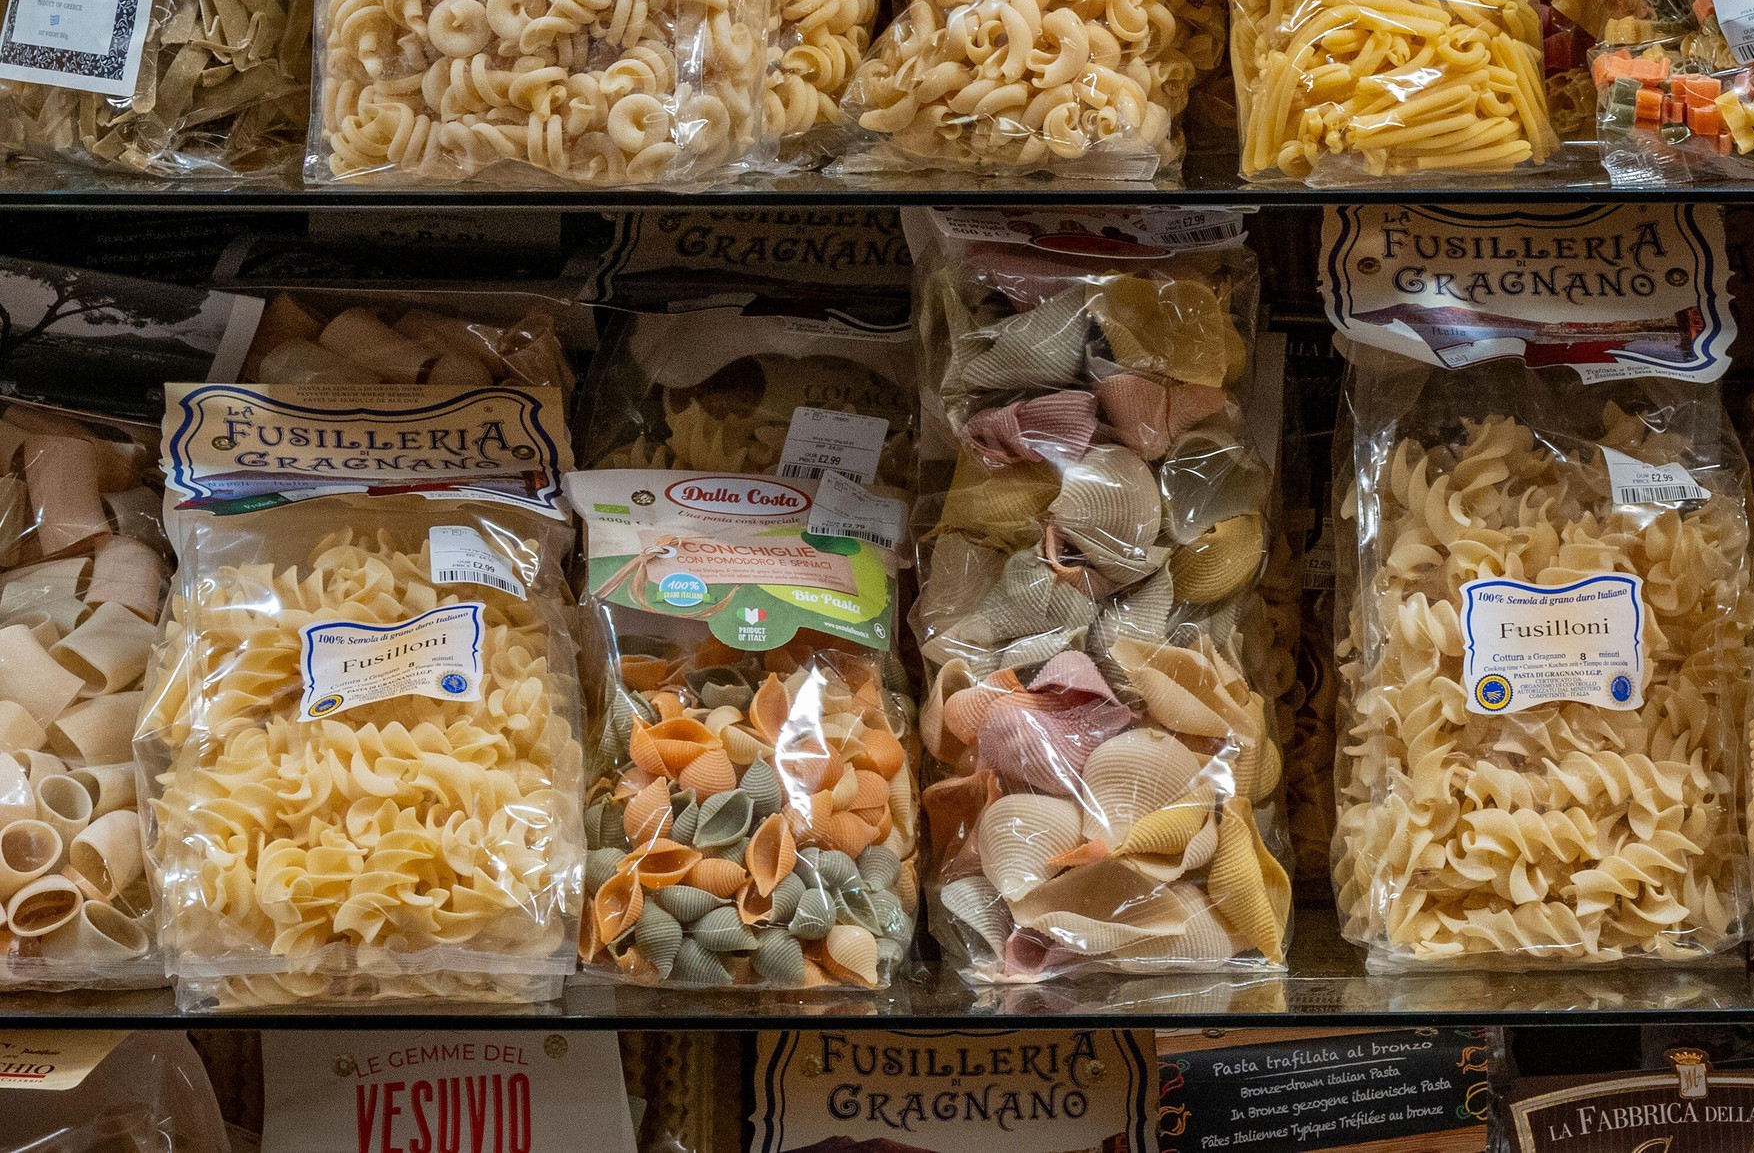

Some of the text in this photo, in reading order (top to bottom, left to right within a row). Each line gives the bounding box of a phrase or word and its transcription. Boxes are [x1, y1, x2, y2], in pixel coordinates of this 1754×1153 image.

[1382, 222, 1667, 267] FUSILLERIA
[1393, 268, 1655, 304] GRAGNANO
[224, 419, 511, 460] FUSILLERIA
[234, 452, 500, 471] GRAGNANO
[818, 456, 840, 465] £2.99
[1651, 473, 1673, 484] £2.99
[683, 486, 799, 507] Dalla Costa
[683, 540, 816, 557] CONCHIGLIE
[472, 561, 495, 573] £2.99
[1500, 618, 1610, 640] Fusilloni
[342, 633, 448, 674] Fusilloni
[354, 1044, 529, 1078] LE GEMME DEL
[820, 1033, 1098, 1088] FUSILLERIA
[1213, 1042, 1432, 1077] Pasta trafilata al bronzo
[1231, 1079, 1452, 1120] In Bronze gezogene italienische Pasta
[1241, 1067, 1400, 1099] Bronze-drawn italian Pasta
[356, 1072, 532, 1153] VESUVIO
[827, 1085, 1090, 1132] GRAGNANO
[1201, 1104, 1443, 1148] Pâtes Italiennes Typiques Tréfilées au bronze
[1549, 1124, 1572, 1141] LA
[1576, 1101, 1699, 1135] FABBRICA
